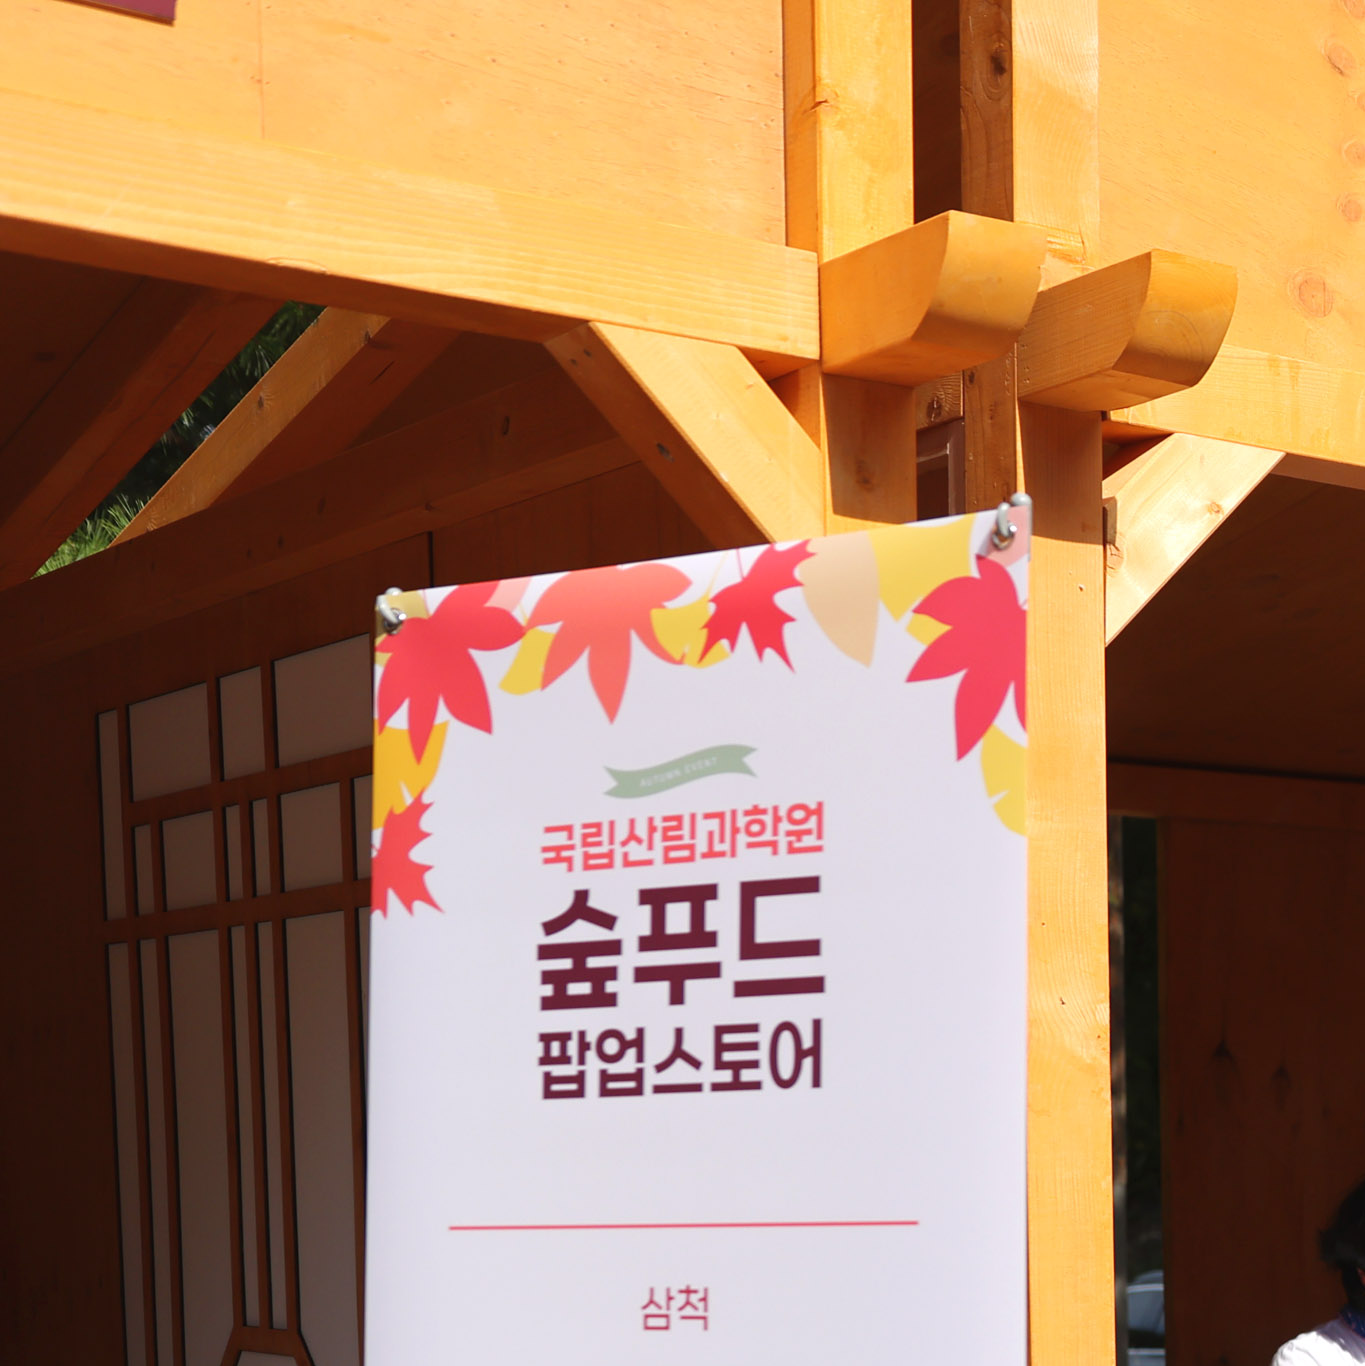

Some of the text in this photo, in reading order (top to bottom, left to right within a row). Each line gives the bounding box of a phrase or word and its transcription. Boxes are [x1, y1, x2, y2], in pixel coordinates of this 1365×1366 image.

[540, 800, 826, 873] 국립산림과학원
[536, 875, 826, 1012] 숲푸드
[537, 1018, 824, 1101] 팝업스토어
[640, 1285, 710, 1332] 삼척
